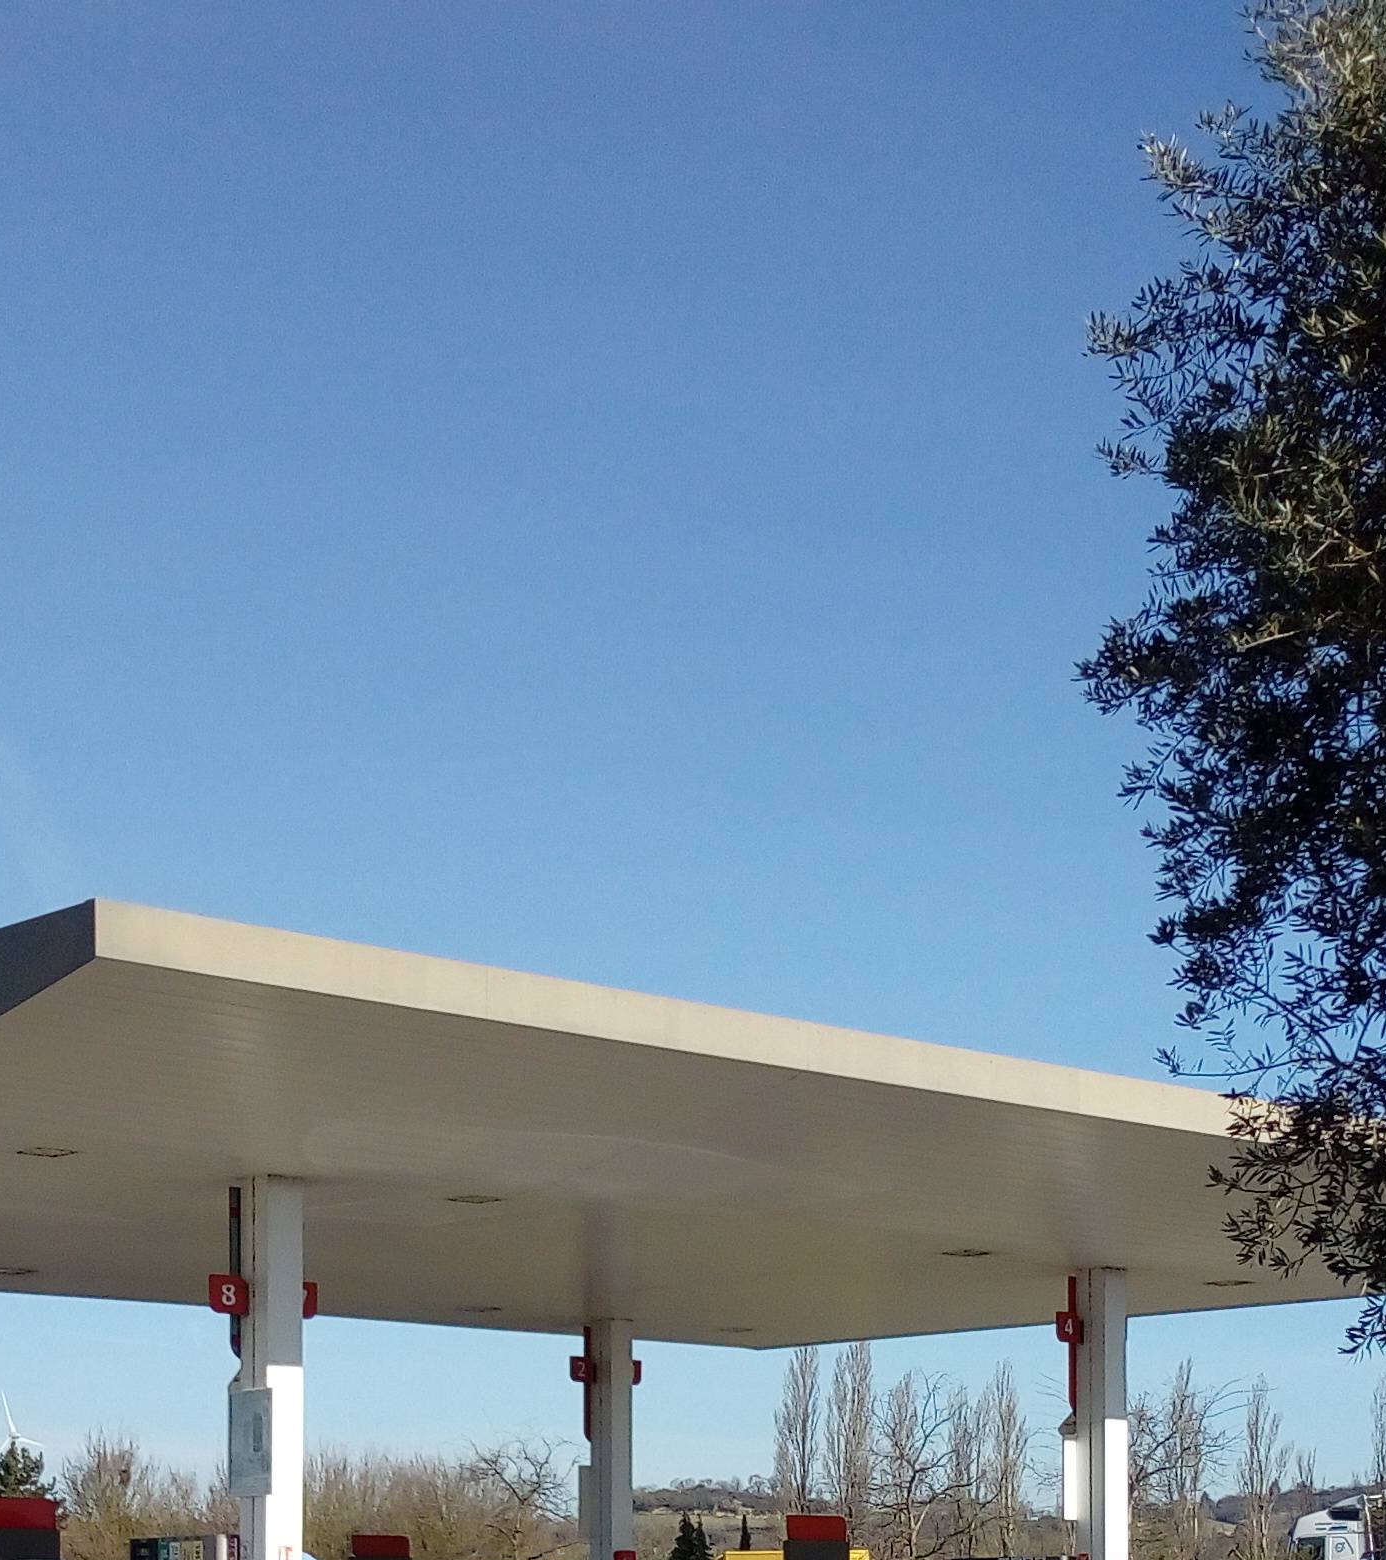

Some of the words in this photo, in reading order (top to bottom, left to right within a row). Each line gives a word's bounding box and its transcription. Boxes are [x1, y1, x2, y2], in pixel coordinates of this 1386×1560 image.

[221, 1284, 236, 1305] 8
[1065, 1318, 1073, 1335] 4
[577, 1362, 586, 1377] 2
